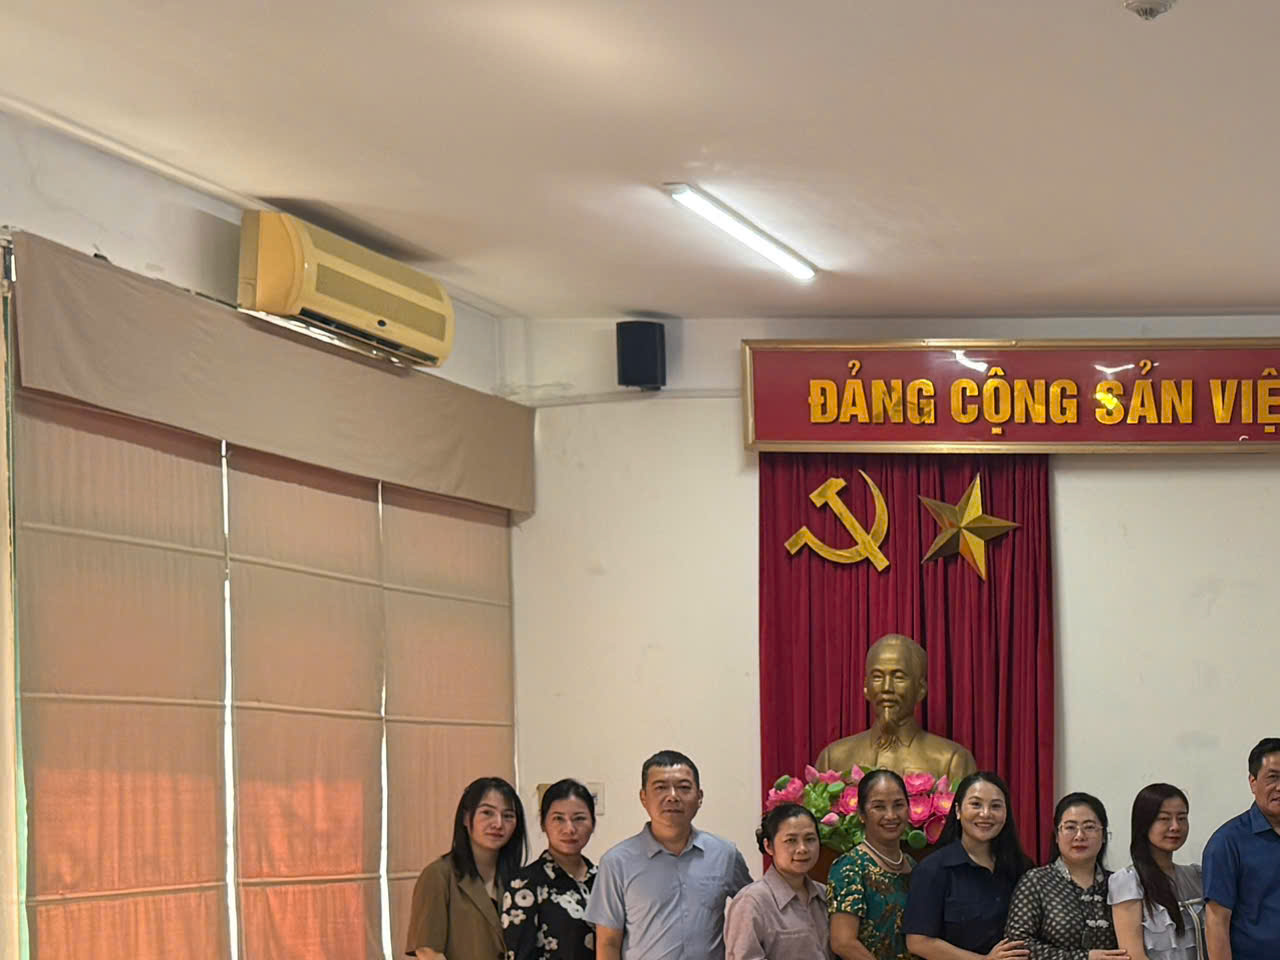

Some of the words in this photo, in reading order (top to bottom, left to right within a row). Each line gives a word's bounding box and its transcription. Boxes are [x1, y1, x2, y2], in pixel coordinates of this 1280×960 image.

[808, 359, 935, 424] ĐẢNG
[950, 367, 1078, 434] CỘNG
[1094, 359, 1193, 424] SẢN
